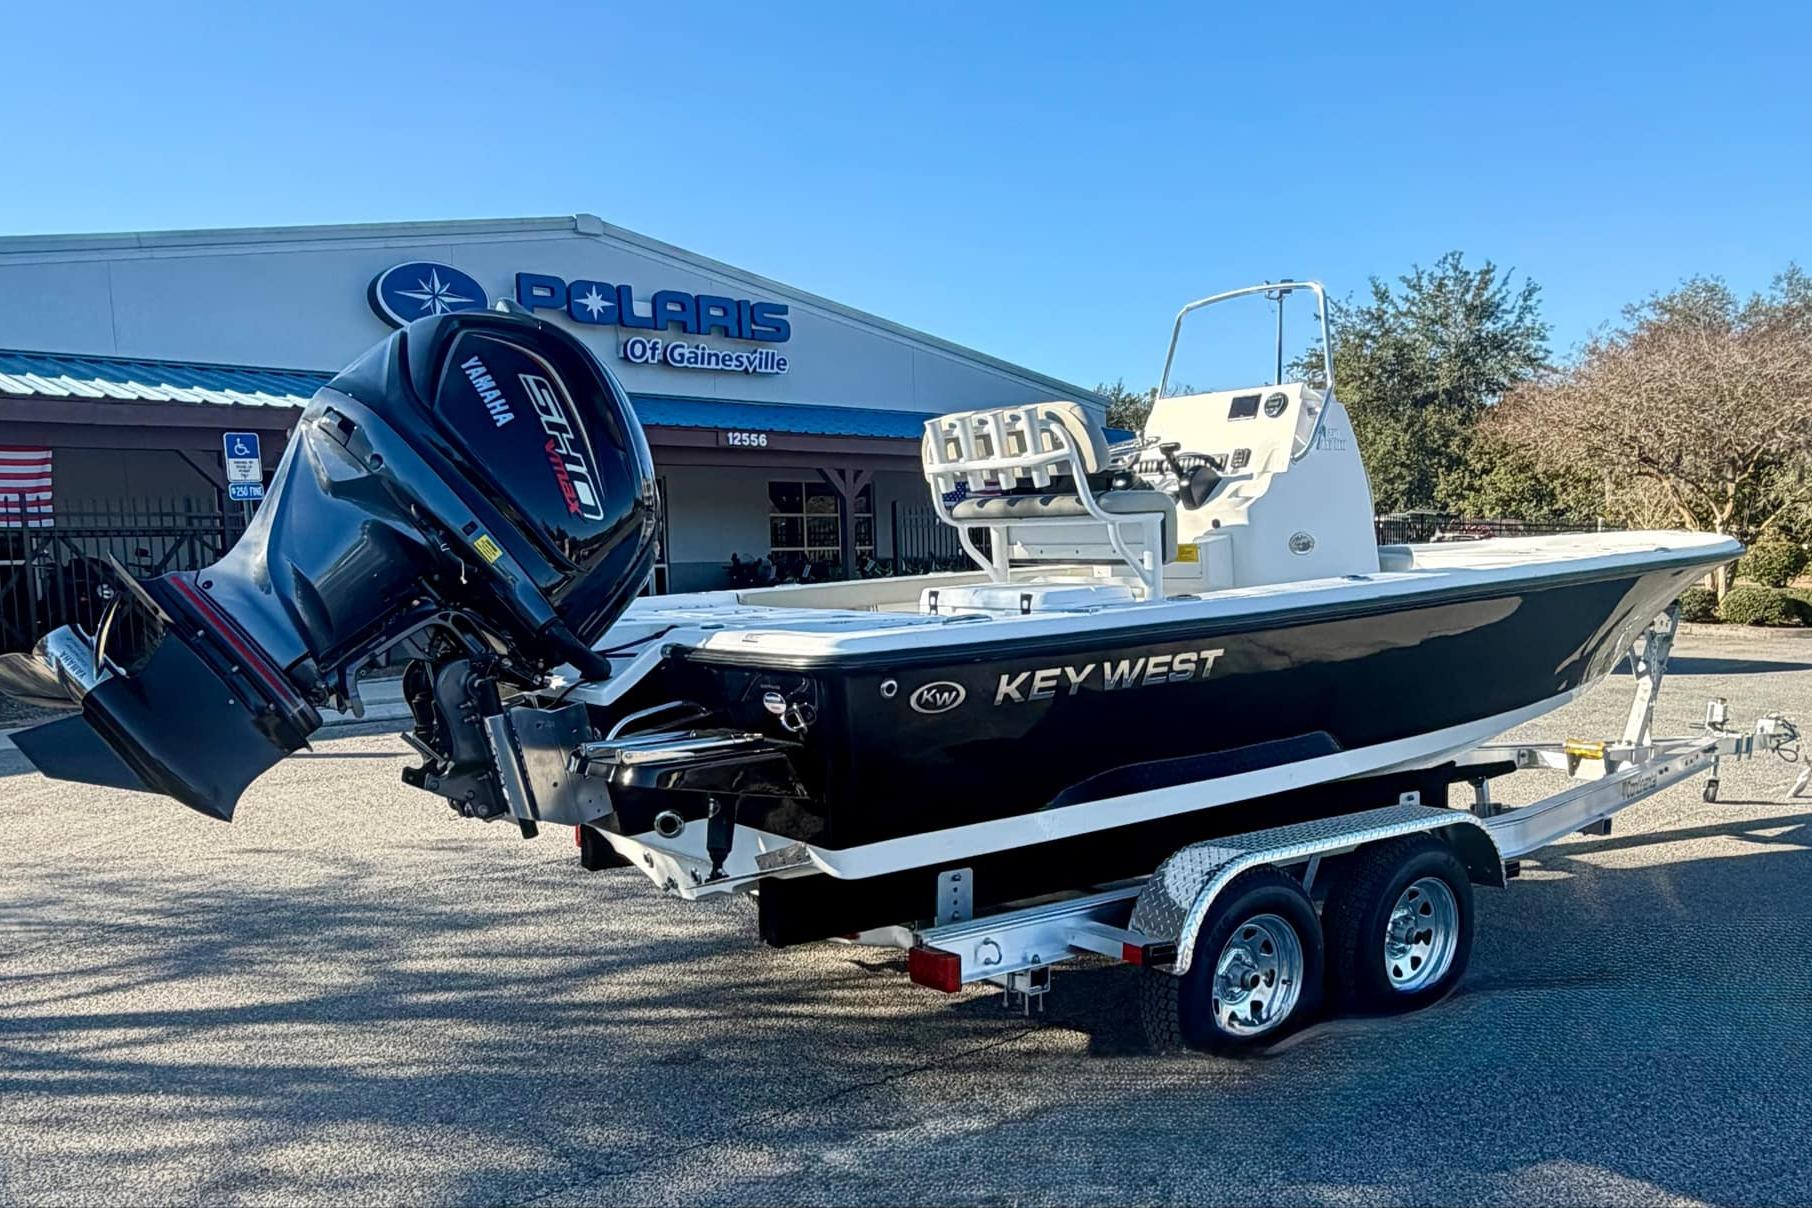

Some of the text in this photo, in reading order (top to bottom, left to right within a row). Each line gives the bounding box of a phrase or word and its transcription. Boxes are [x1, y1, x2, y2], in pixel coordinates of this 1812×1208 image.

[515, 272, 791, 343] POLARIS
[626, 337, 789, 374] Of Gainesville
[460, 355, 515, 428] YAMAHA
[518, 373, 604, 521] SHO
[727, 432, 768, 447] 12556
[920, 687, 957, 707] KW
[993, 649, 1225, 705] KEY WEST
